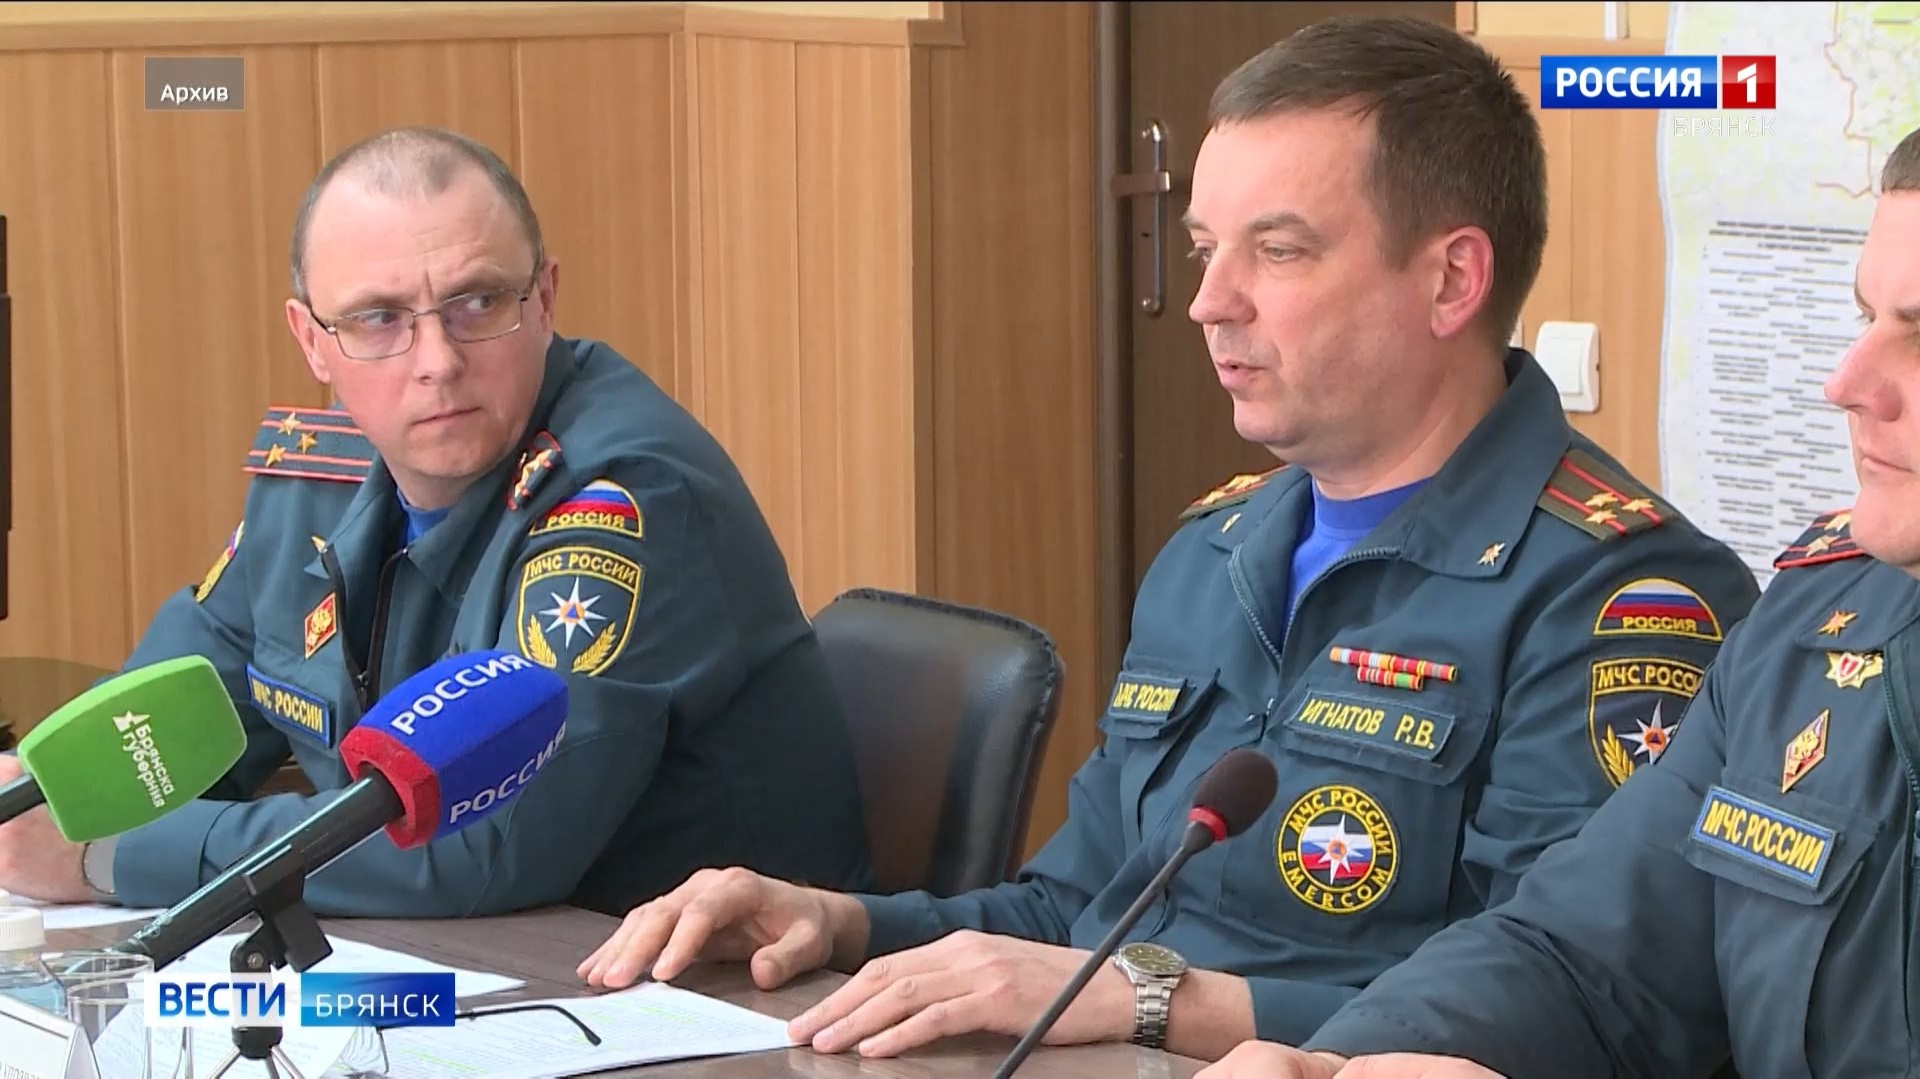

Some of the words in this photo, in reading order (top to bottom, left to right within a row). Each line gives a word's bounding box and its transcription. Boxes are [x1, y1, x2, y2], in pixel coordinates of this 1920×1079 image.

[547, 511, 625, 528] РОССИЯ
[529, 555, 563, 577] МЧС
[568, 552, 637, 584] РОССИИ
[1622, 616, 1697, 632] РОССИЯ
[390, 653, 533, 735] РОССИЯ
[1133, 683, 1181, 712] РОССИИ
[1598, 665, 1641, 689] МЧС
[274, 690, 323, 733] РОССИИ
[1298, 698, 1385, 735] ИГНАТОВ
[1394, 713, 1436, 750] Р.В.
[449, 721, 567, 824] РОССИЯ
[1288, 794, 1325, 834] МЧС
[1330, 790, 1393, 855] РОССИИ
[1702, 800, 1746, 842] МЧС
[1742, 814, 1825, 875] РОССИИ
[1281, 850, 1390, 909] EMERCOM
